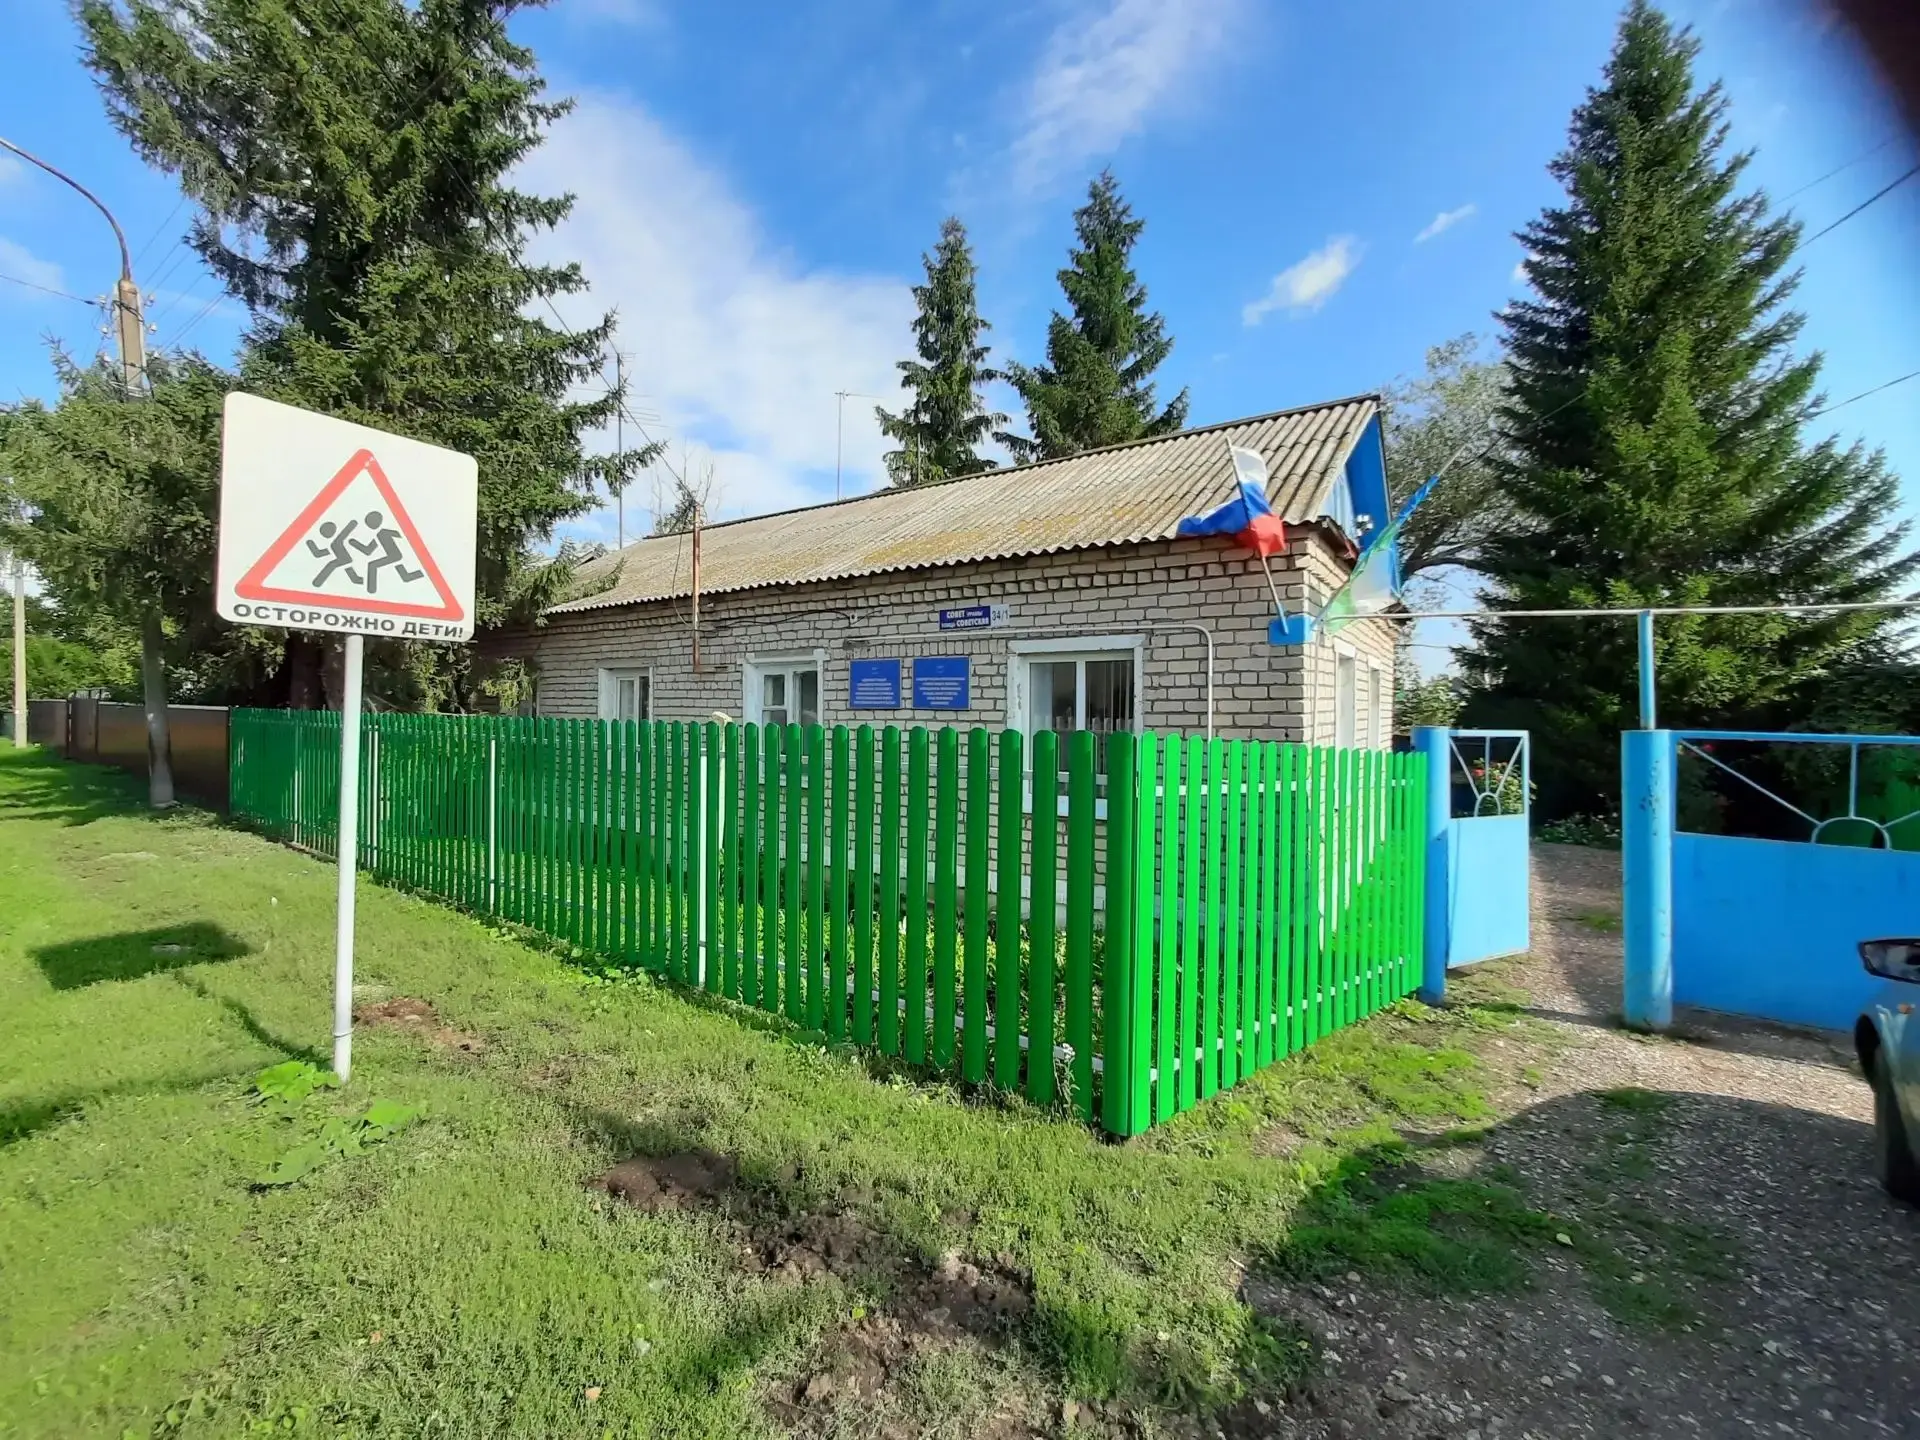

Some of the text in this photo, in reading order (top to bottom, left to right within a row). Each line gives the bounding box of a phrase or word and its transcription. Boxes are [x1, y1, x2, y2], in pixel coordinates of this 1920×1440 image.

[233, 603, 464, 639] ОСТОРОЖНО ДЕТИ!
[992, 610, 1009, 621] 34/1
